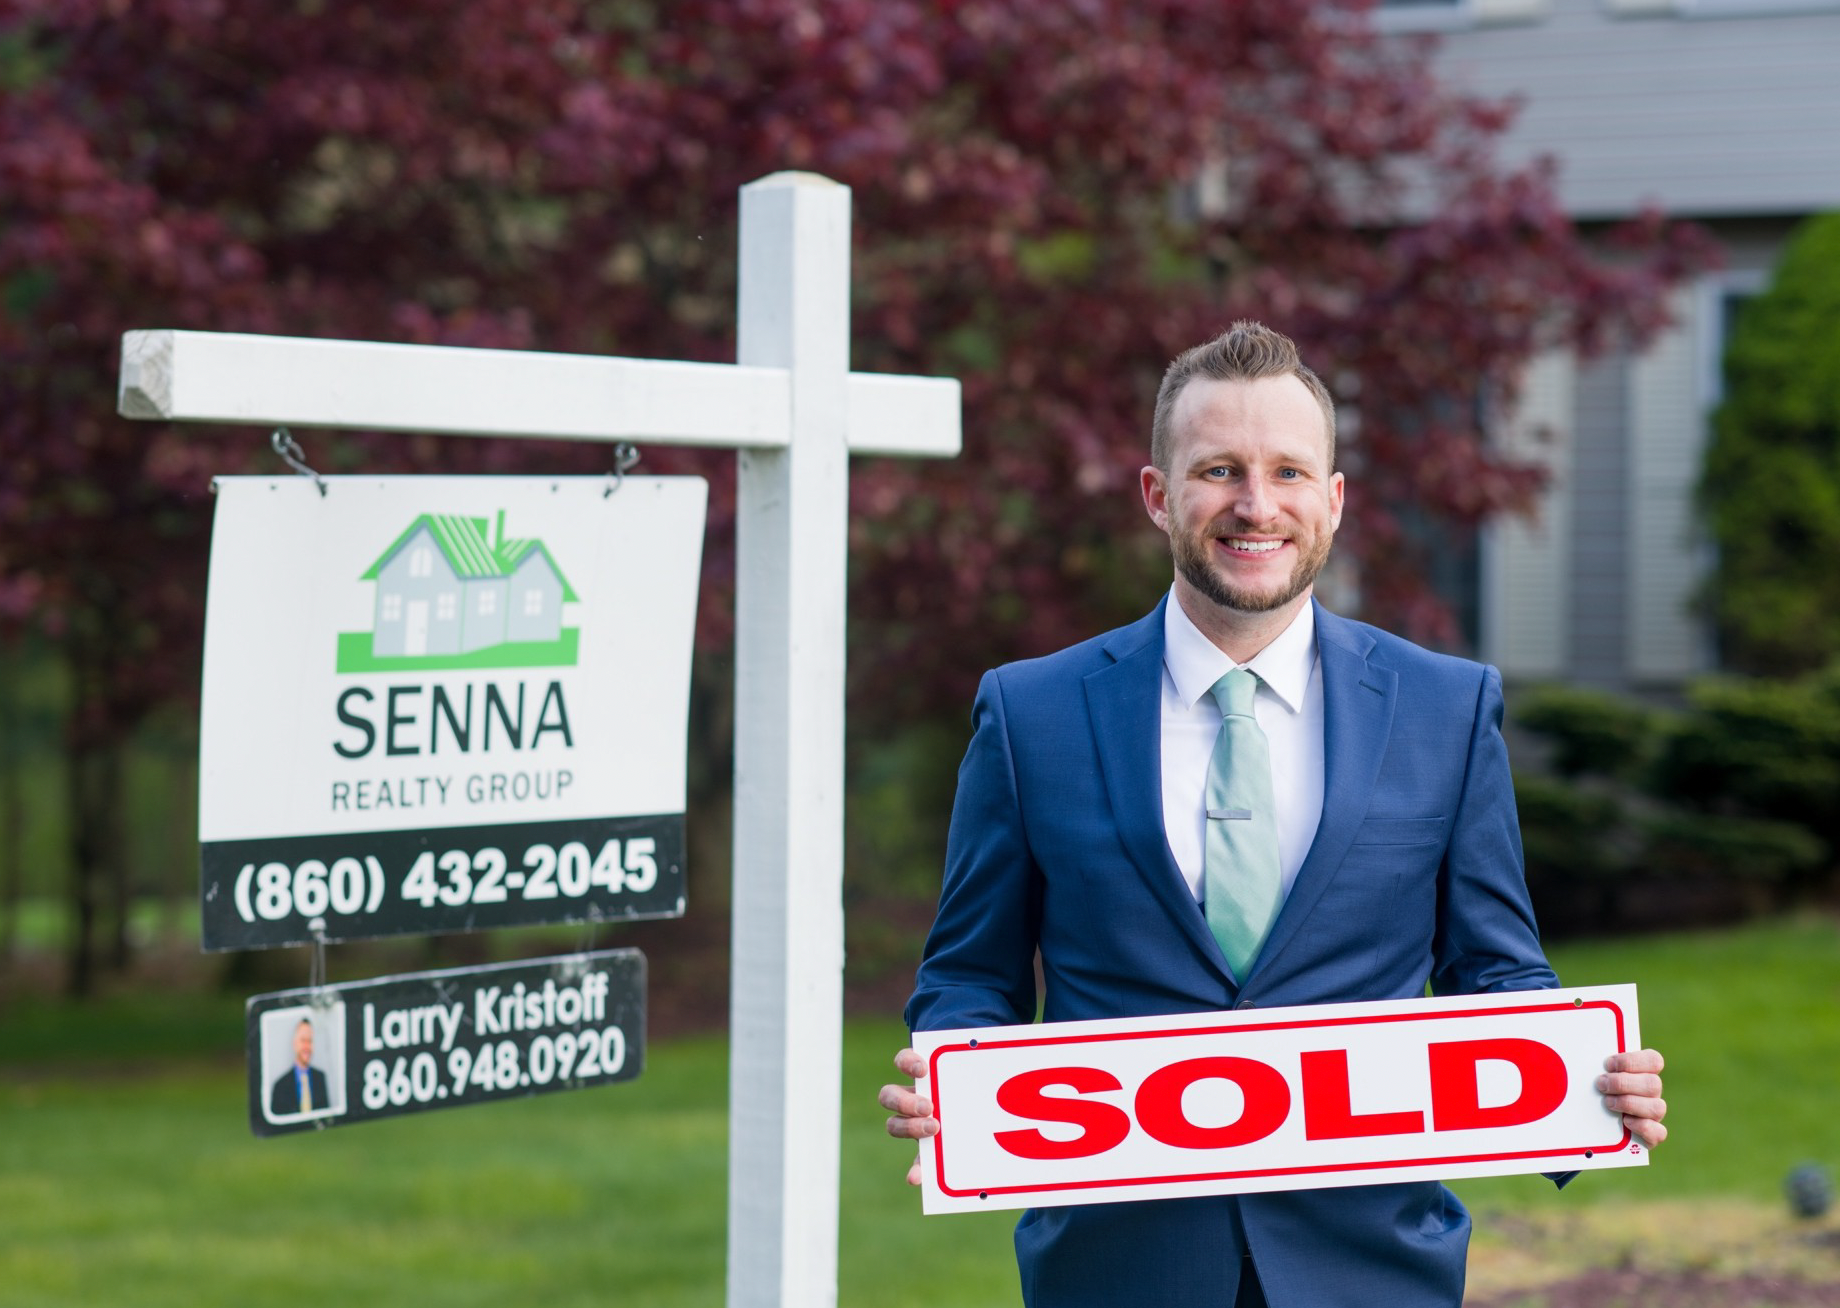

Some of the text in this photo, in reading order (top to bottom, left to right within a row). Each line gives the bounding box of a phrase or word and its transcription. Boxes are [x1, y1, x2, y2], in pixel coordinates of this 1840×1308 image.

[332, 680, 575, 760] SENNA
[331, 770, 574, 812] REALTY GROUP
[234, 837, 658, 922] (860) 432-2045
[363, 971, 610, 1052] Larry Kristoff
[362, 1025, 625, 1110] 860.948.0920
[993, 1037, 1569, 1160] SOLD
